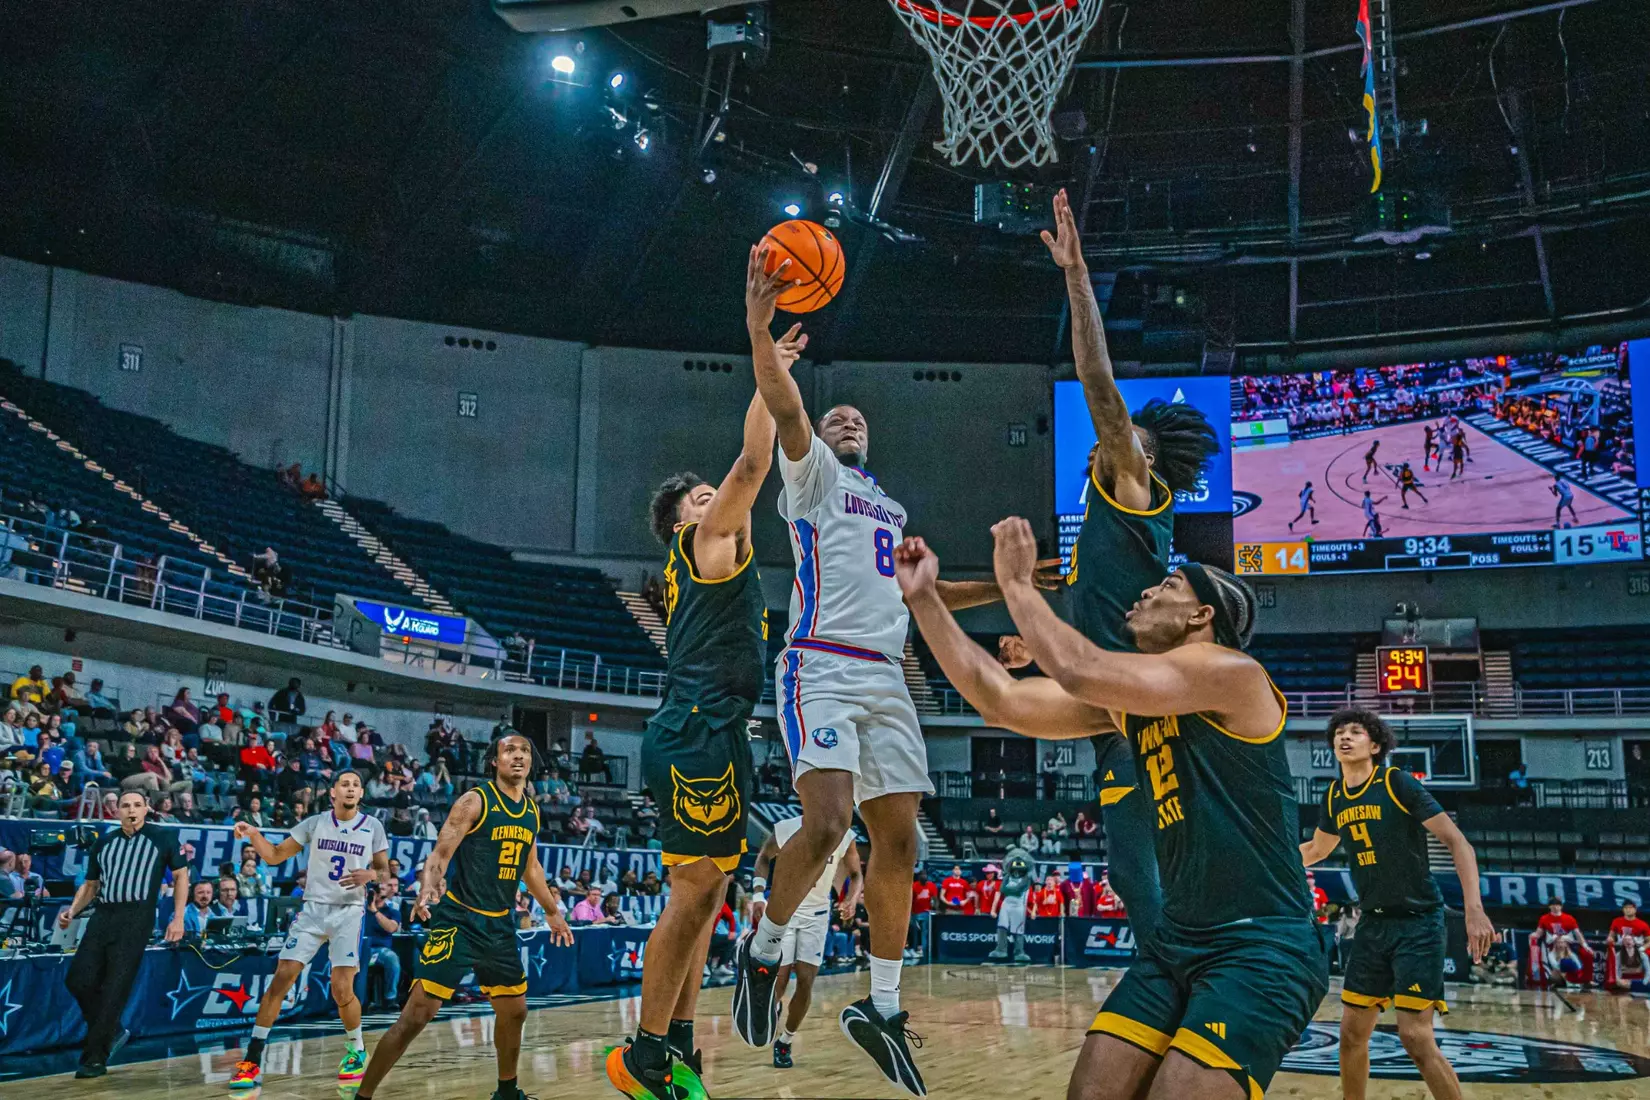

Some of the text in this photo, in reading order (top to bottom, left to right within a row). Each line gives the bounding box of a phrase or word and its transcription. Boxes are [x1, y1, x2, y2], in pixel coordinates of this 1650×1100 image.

[122, 352, 140, 371] 311
[459, 399, 477, 417] 312
[1009, 430, 1026, 446] 314
[1311, 541, 1365, 553] TIMEOUTS 3
[1404, 537, 1451, 555] 9:34
[1492, 536, 1538, 545] TIMEOUTS
[1511, 545, 1538, 554] FOULS
[1560, 536, 1594, 557] 15
[873, 526, 898, 578] 8
[1275, 548, 1306, 570] 14
[1311, 552, 1349, 563] FOULS 3
[1471, 553, 1500, 564] POSS
[1419, 556, 1438, 568] 1ST
[1390, 650, 1424, 665] 9:34
[1387, 665, 1421, 690] 24
[1056, 746, 1073, 765] 211
[1312, 749, 1333, 768] 212
[1587, 749, 1611, 768] 213
[1336, 804, 1382, 830] KENNESAW
[1348, 822, 1373, 849] 4
[317, 838, 366, 857] LOUISIANA TECH
[498, 840, 524, 867] 21
[542, 847, 620, 882] LIMITS
[1356, 850, 1378, 867] STATE
[328, 855, 346, 882] 3
[498, 867, 517, 881] STATE
[948, 931, 967, 942] CBS
[967, 932, 998, 943] SPORT
